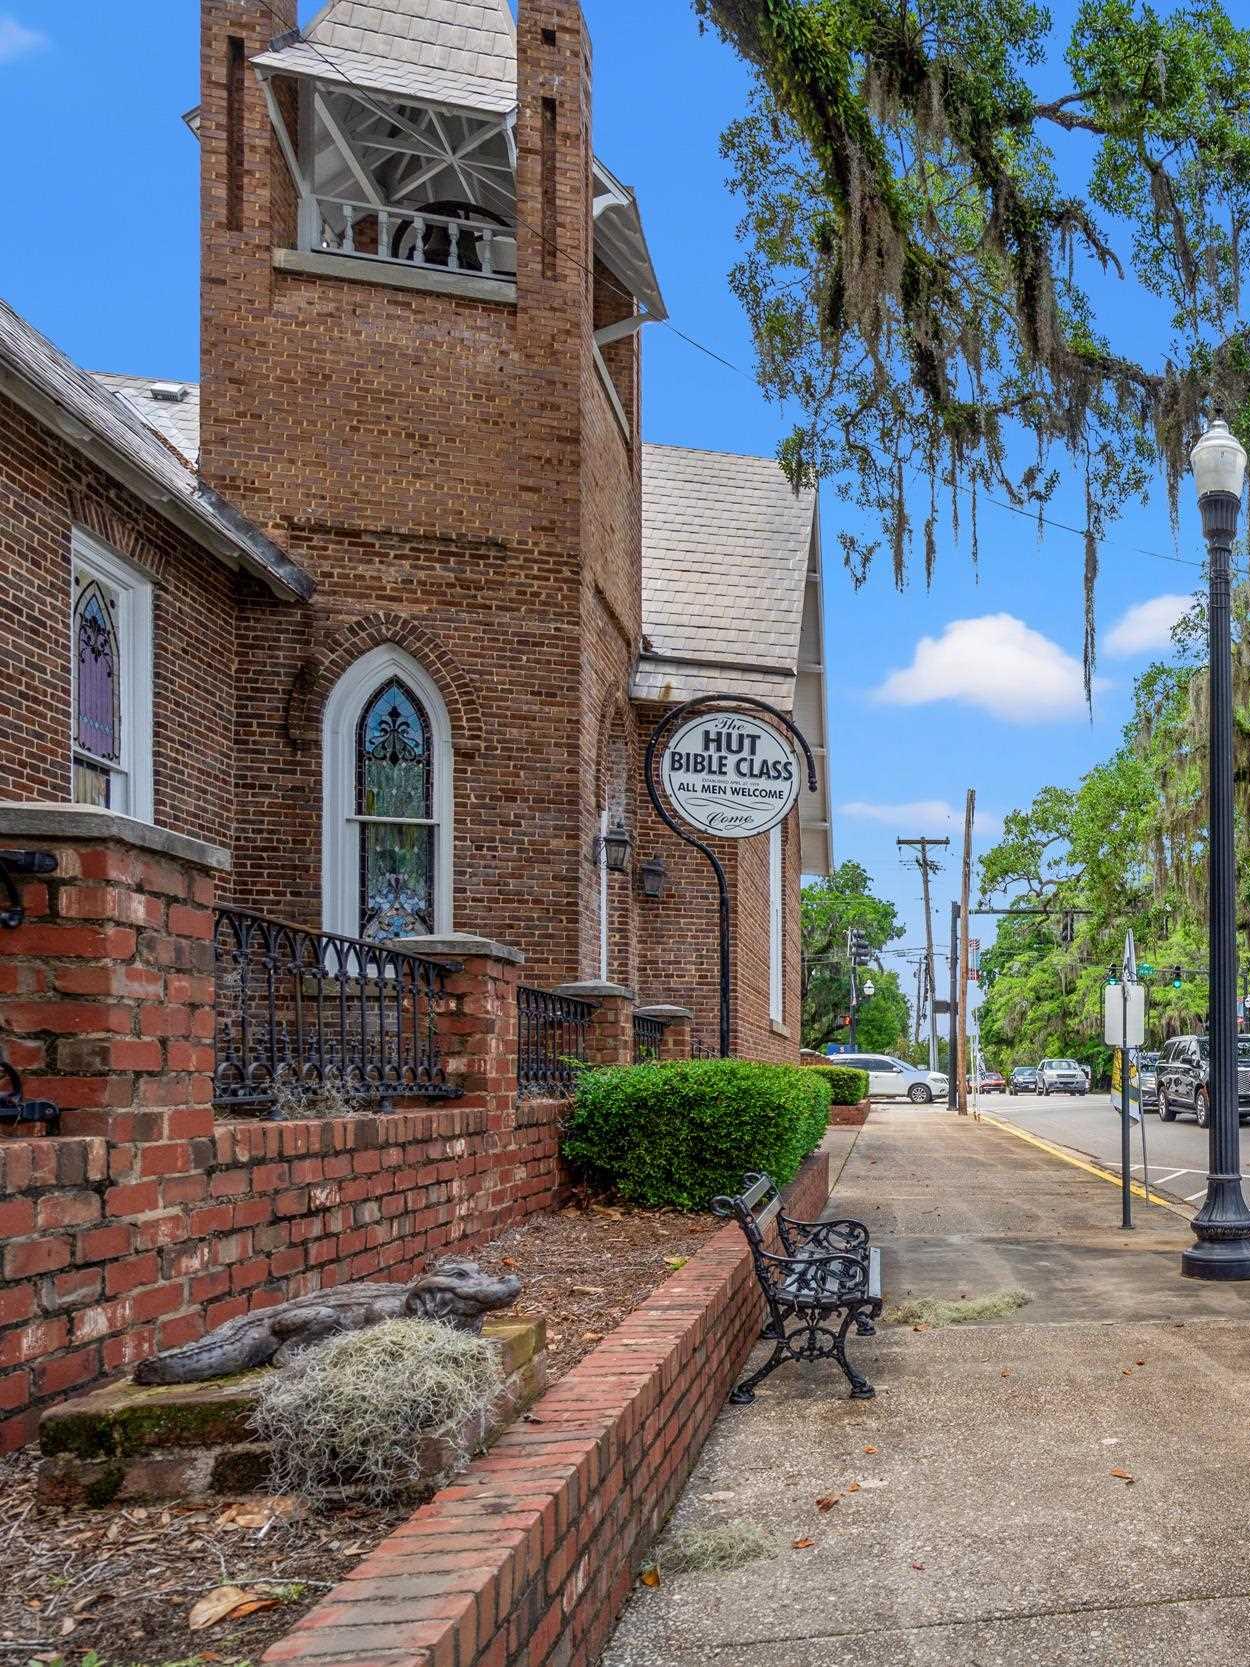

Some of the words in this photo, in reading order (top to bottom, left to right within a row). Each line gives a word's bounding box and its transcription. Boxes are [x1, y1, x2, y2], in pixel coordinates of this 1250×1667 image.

[715, 717, 745, 730] The
[703, 730, 761, 756] HUT
[670, 751, 728, 775] BIBLE
[735, 757, 793, 780] CLASS
[678, 782, 698, 792] ALL
[701, 784, 727, 795] MEN
[730, 787, 784, 800] WELCOME
[707, 811, 755, 829] Come
